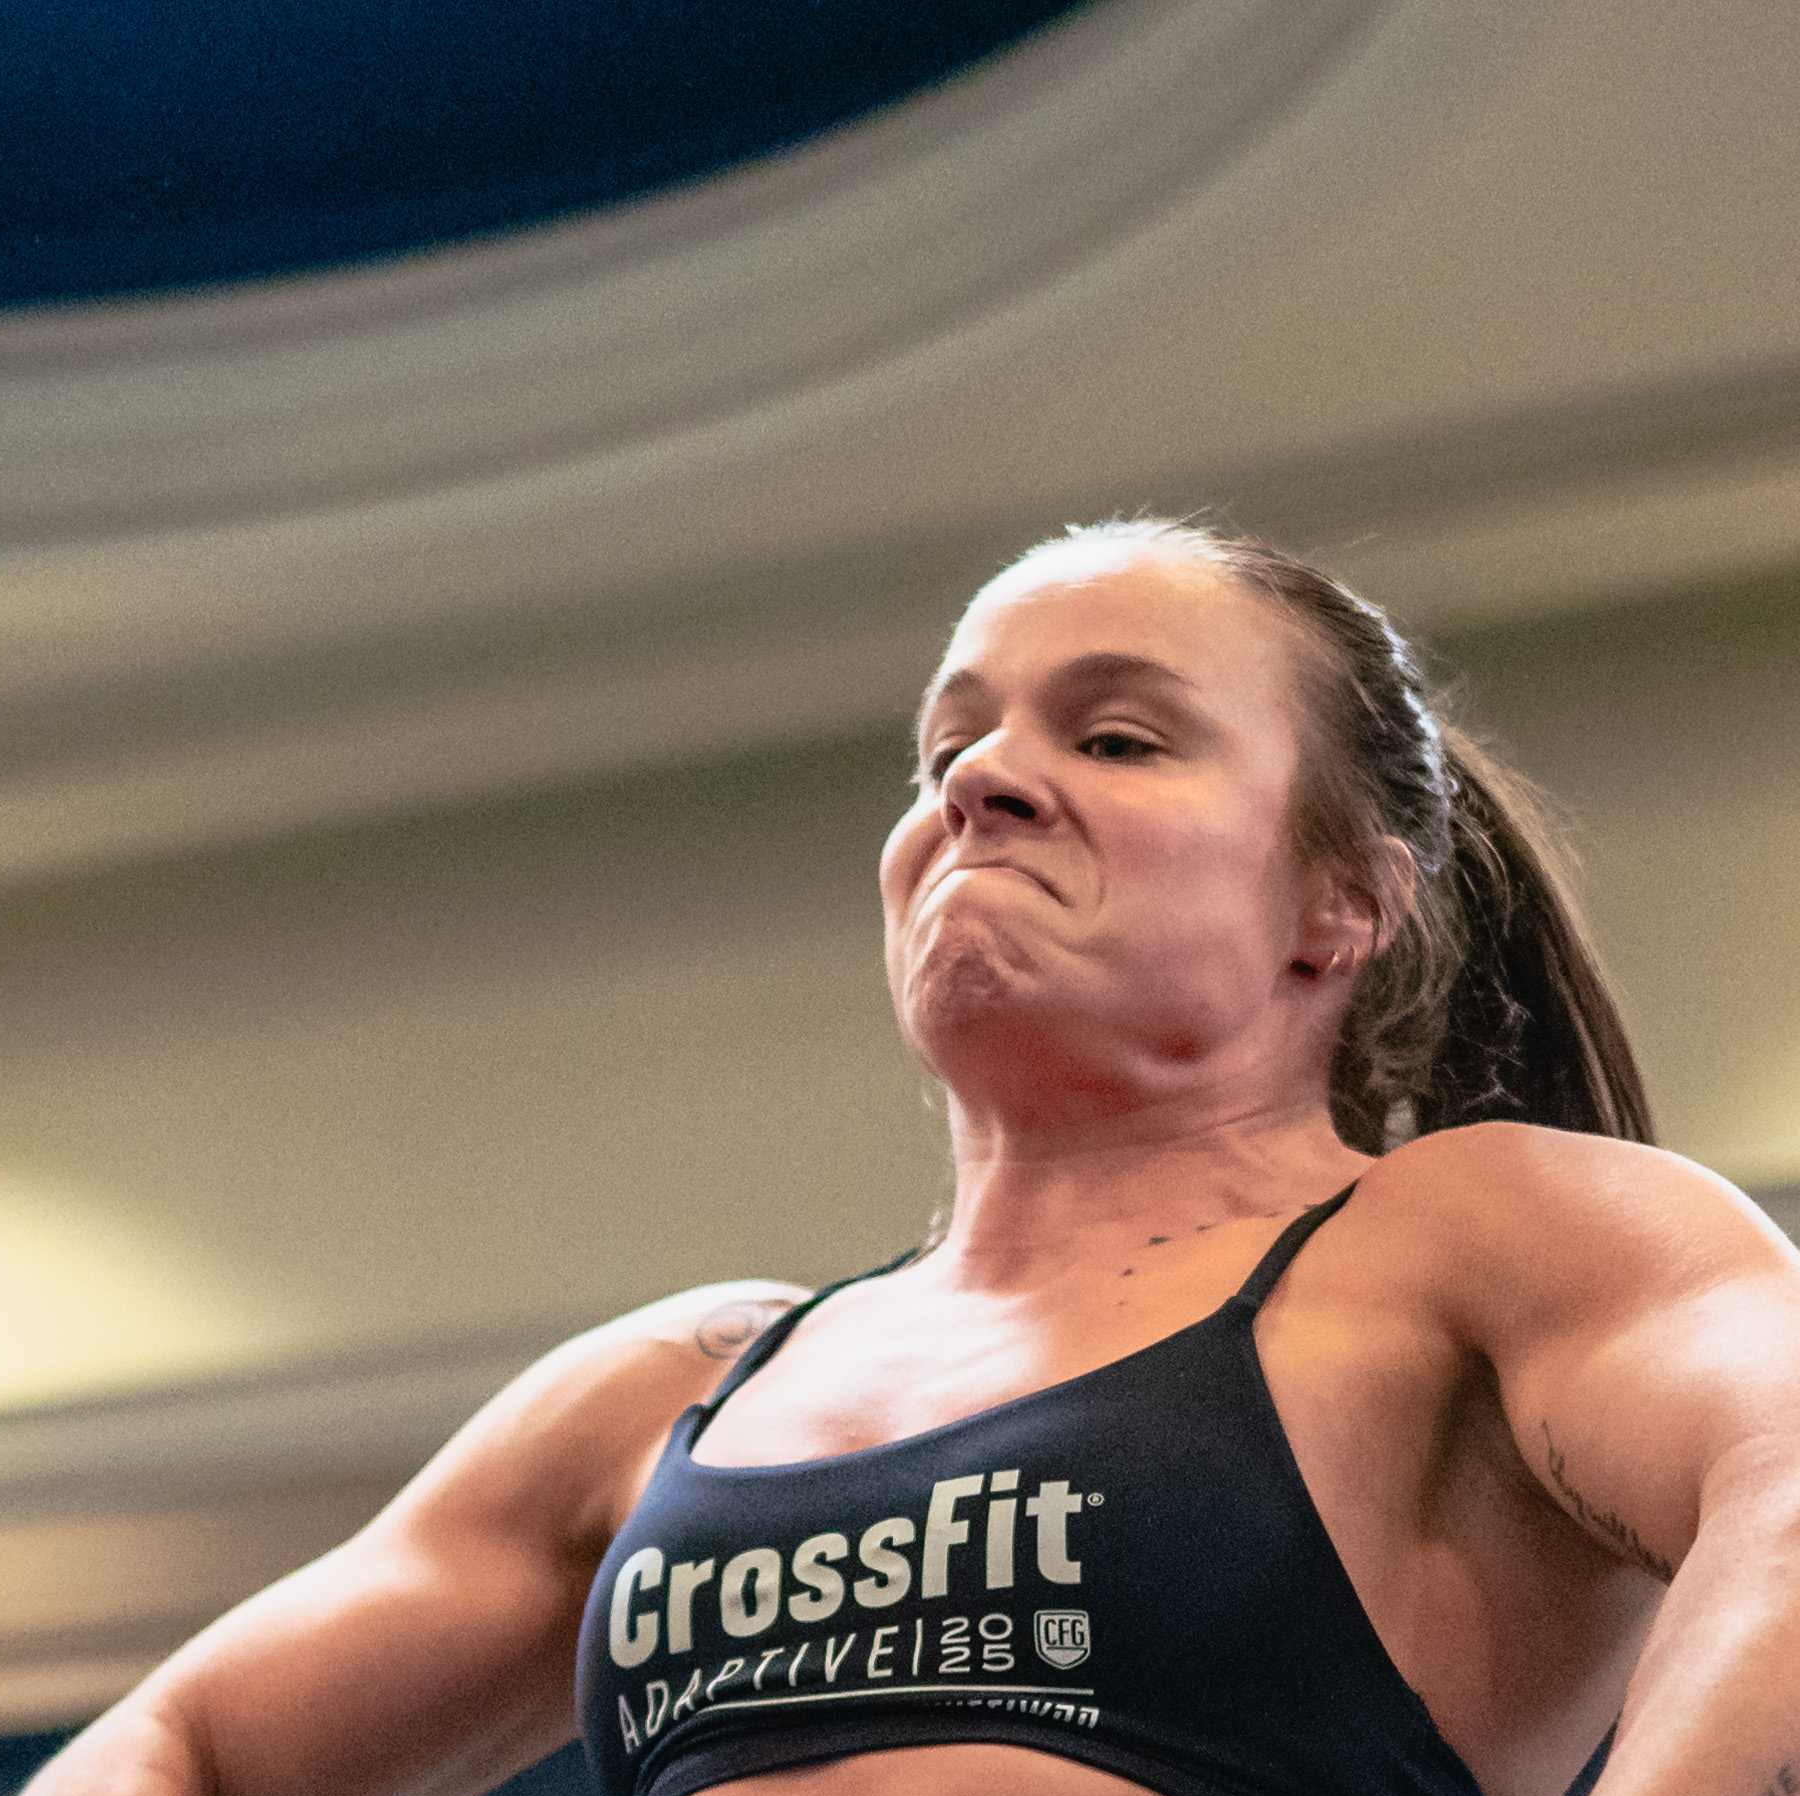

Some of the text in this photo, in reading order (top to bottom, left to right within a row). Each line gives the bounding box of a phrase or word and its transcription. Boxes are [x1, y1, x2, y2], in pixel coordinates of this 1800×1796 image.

[1044, 1618, 1085, 1646] CFG
[938, 1643, 1015, 1673] 25
[617, 1613, 1014, 1753] ADAPTIVE 20
